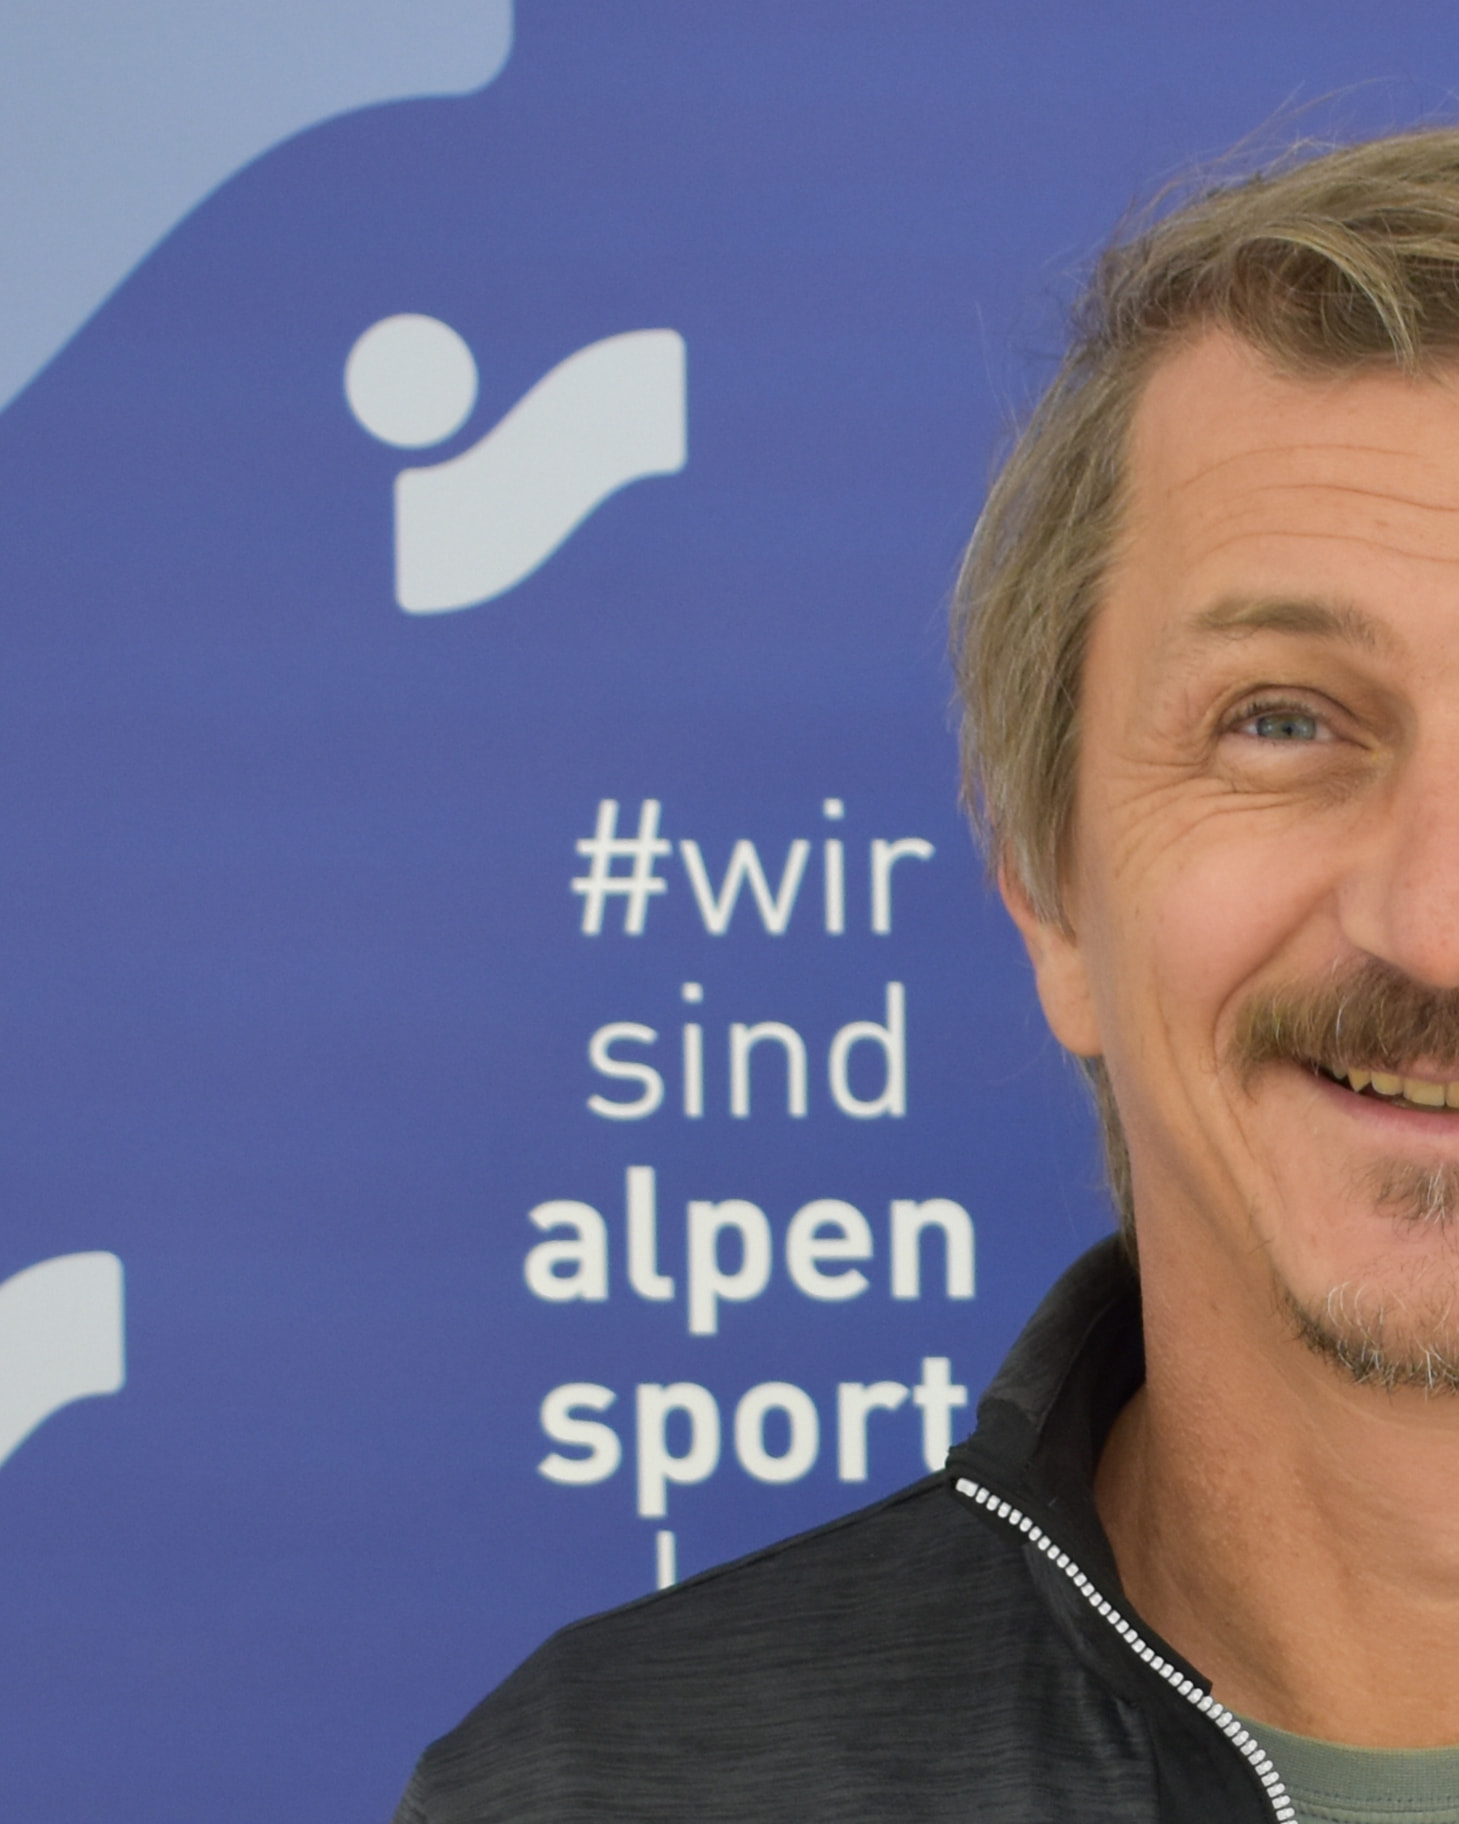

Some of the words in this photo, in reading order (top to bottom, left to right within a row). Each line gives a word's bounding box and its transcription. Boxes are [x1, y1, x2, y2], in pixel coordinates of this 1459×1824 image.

[570, 798, 936, 936] #wir
[586, 981, 907, 1120] sind
[523, 1165, 976, 1336] alpen
[537, 1356, 970, 1519] sport
